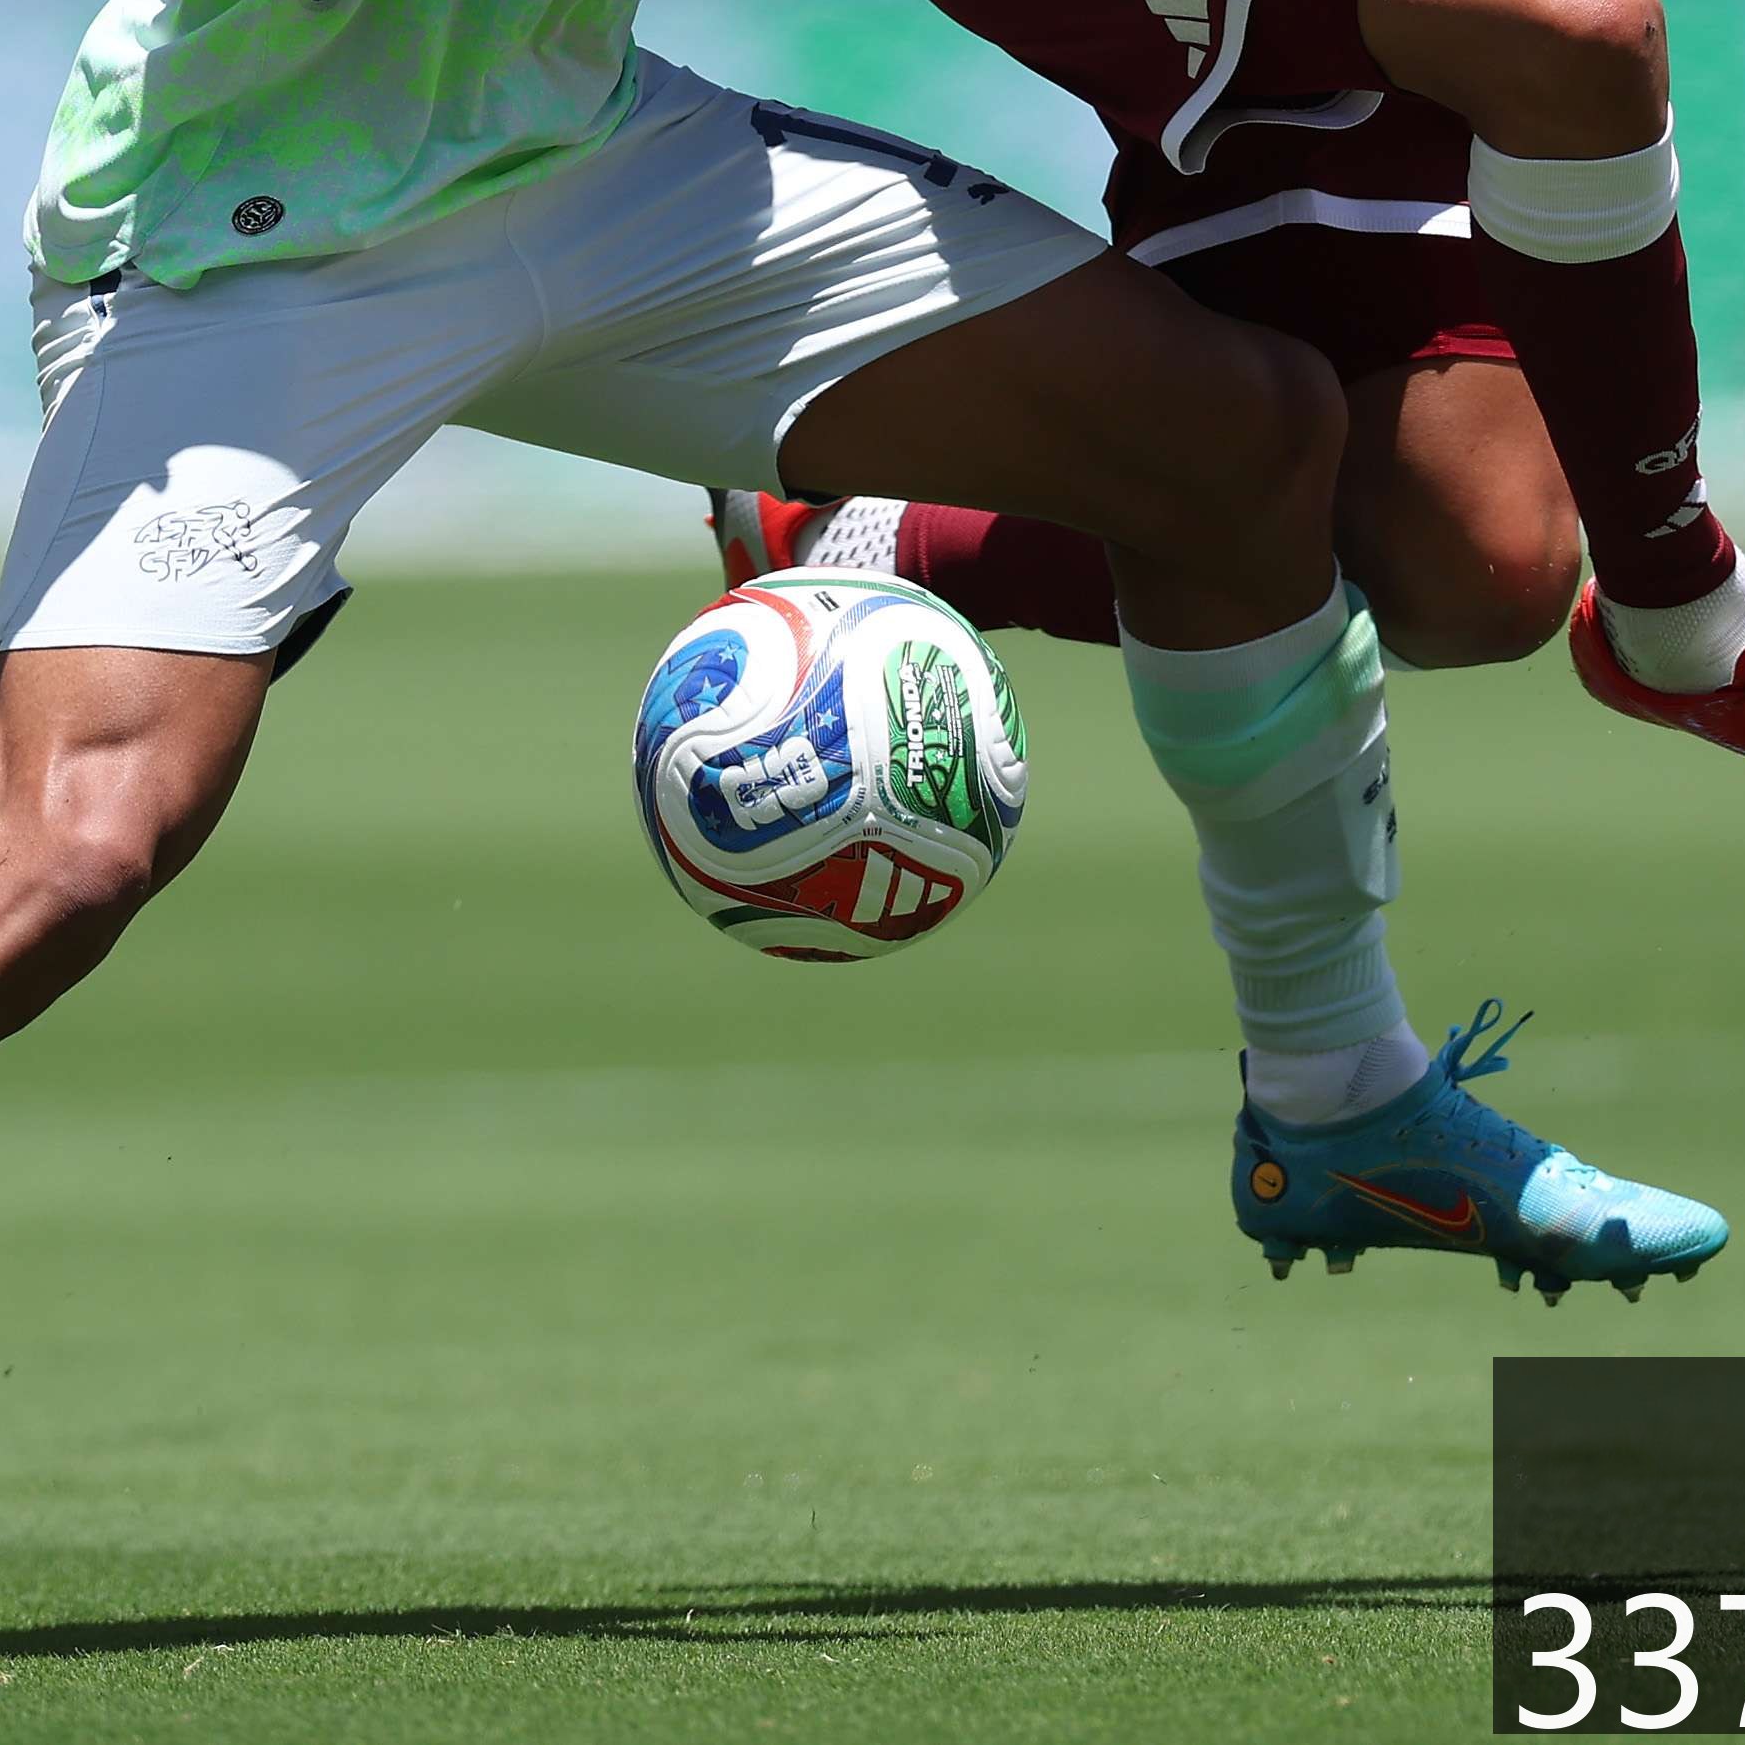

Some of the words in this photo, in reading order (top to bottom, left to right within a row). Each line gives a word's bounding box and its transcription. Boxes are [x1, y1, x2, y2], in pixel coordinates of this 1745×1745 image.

[1635, 405, 1702, 475] QF
[899, 663, 924, 788] TRIONDA
[796, 752, 816, 784] FIFA
